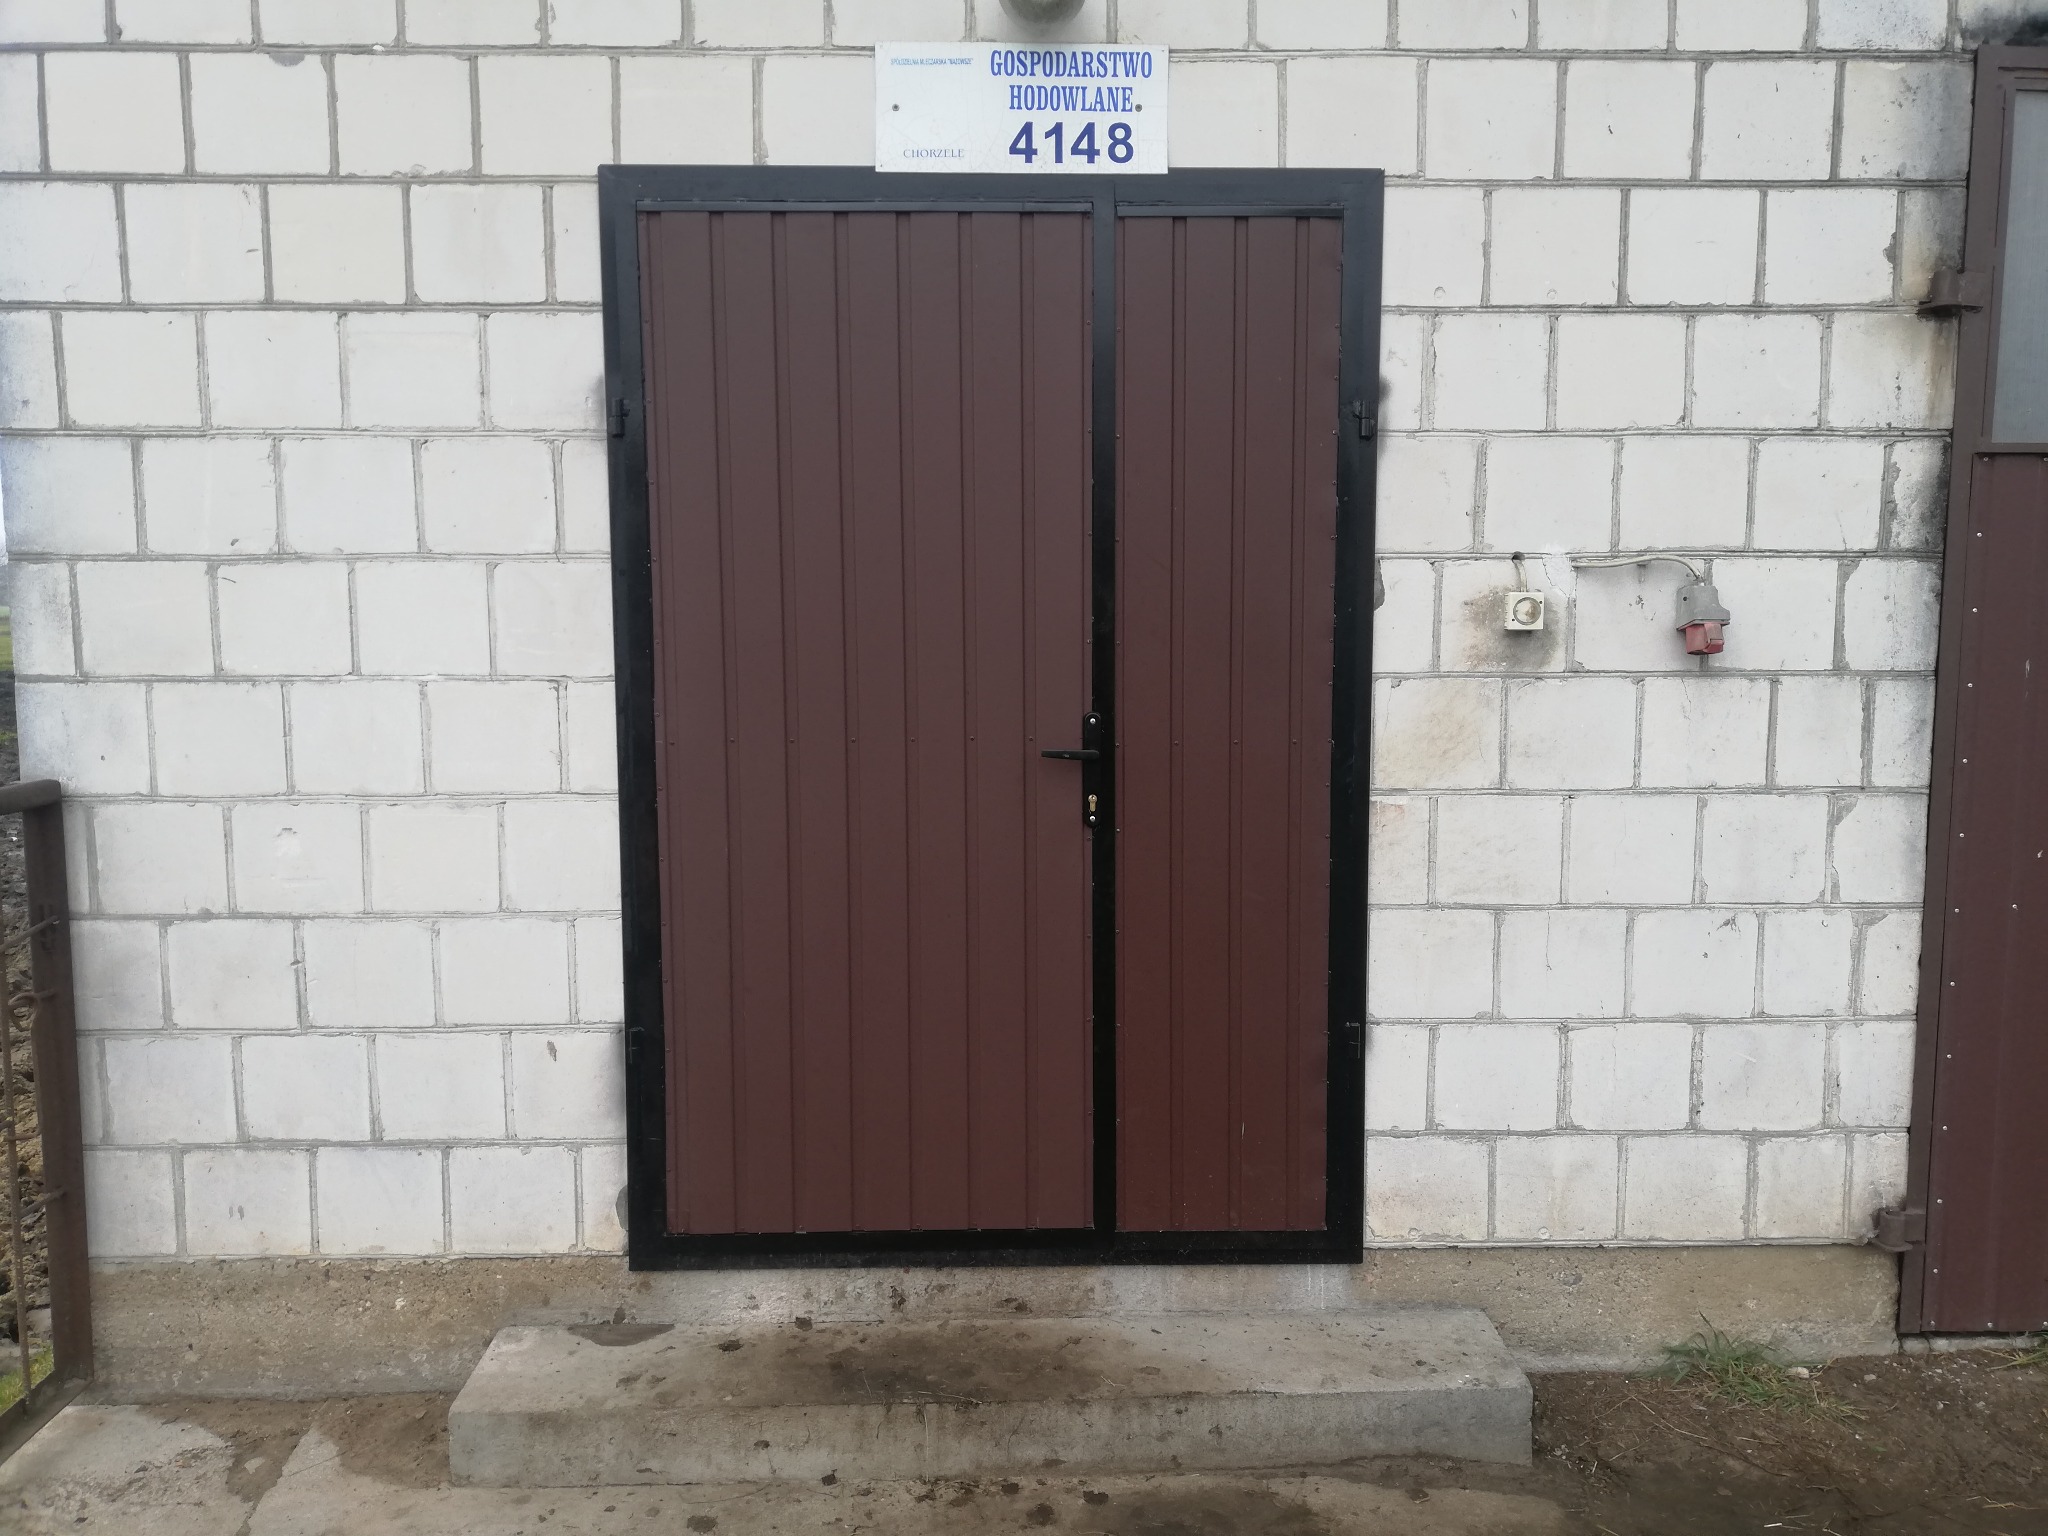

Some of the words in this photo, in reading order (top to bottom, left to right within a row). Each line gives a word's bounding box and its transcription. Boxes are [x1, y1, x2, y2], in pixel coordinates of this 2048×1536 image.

[990, 50, 1153, 79] GOSPODARSTWO
[1009, 84, 1133, 112] HODOWLANE
[903, 148, 965, 159] CHORZELE
[1009, 121, 1134, 164] 4148
